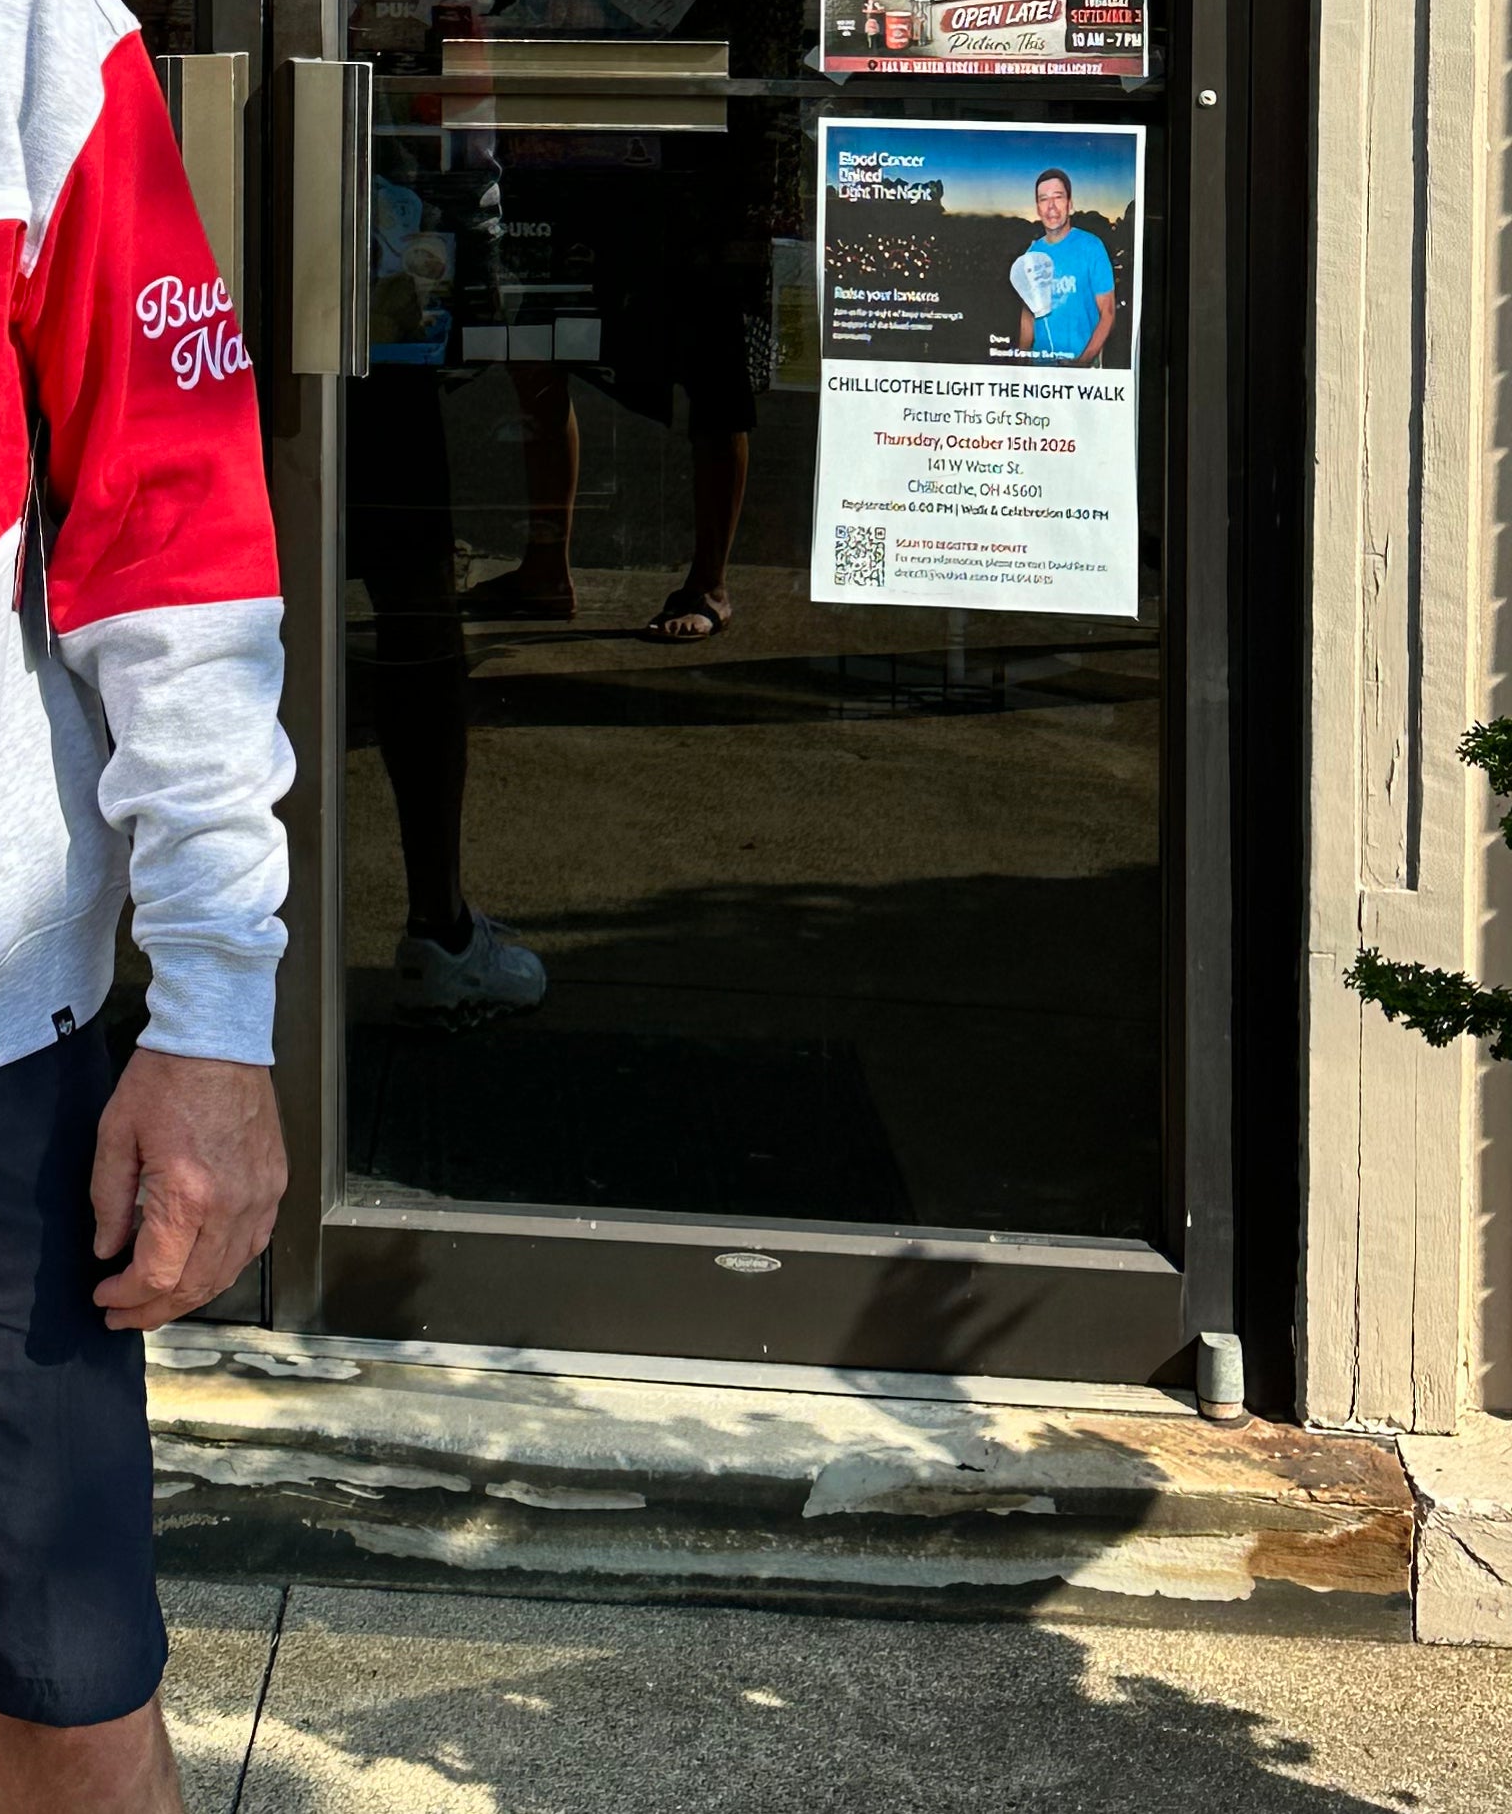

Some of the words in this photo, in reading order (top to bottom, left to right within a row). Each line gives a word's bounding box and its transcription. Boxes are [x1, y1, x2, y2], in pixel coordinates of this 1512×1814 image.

[951, 4, 1004, 30] OPEN
[1005, 0, 1057, 25] LATE!
[1072, 32, 1085, 47] 10
[1087, 33, 1105, 46] AM
[1115, 32, 1124, 46] 7
[1124, 33, 1142, 47] PM
[878, 152, 925, 166] Cancer
[838, 183, 871, 202] Light
[871, 184, 897, 199] The
[897, 184, 932, 204] Night
[828, 377, 934, 395] CHILLICOTHE
[936, 380, 985, 397] LIGHT
[988, 382, 1020, 398] THE
[1023, 384, 1074, 400] NIGHT
[1077, 385, 1126, 402] WALK
[903, 407, 951, 423] Picture
[953, 409, 982, 424] This
[986, 410, 1012, 426] Gift
[1015, 411, 1050, 430] Shop
[873, 431, 943, 451] Thursday,
[946, 435, 1004, 450] October
[1007, 436, 1037, 451] 15th
[1040, 438, 1076, 453] 2026
[927, 458, 945, 471] 141
[948, 459, 963, 472] W
[980, 483, 1000, 497] OH
[1003, 483, 1042, 498] 45601
